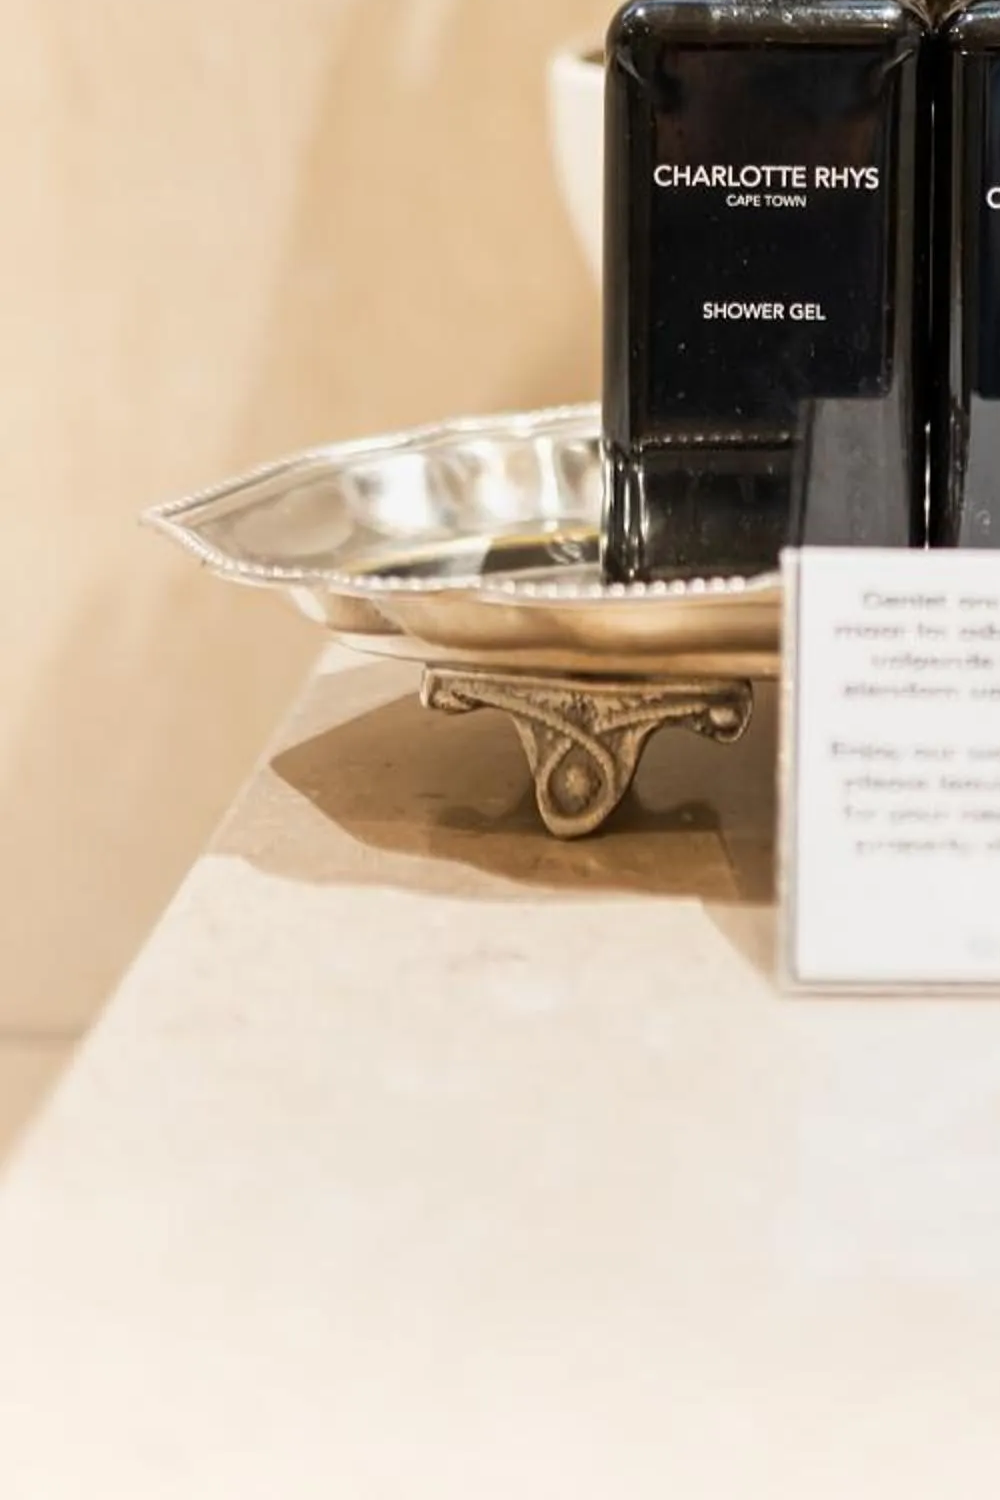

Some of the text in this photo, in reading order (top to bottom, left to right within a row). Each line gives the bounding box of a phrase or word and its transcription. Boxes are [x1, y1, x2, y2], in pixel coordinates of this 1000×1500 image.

[653, 164, 880, 190] CHARLOTTE RHYS
[725, 193, 807, 208] CAPE TOWN
[702, 301, 827, 321] SHOWER GEL
